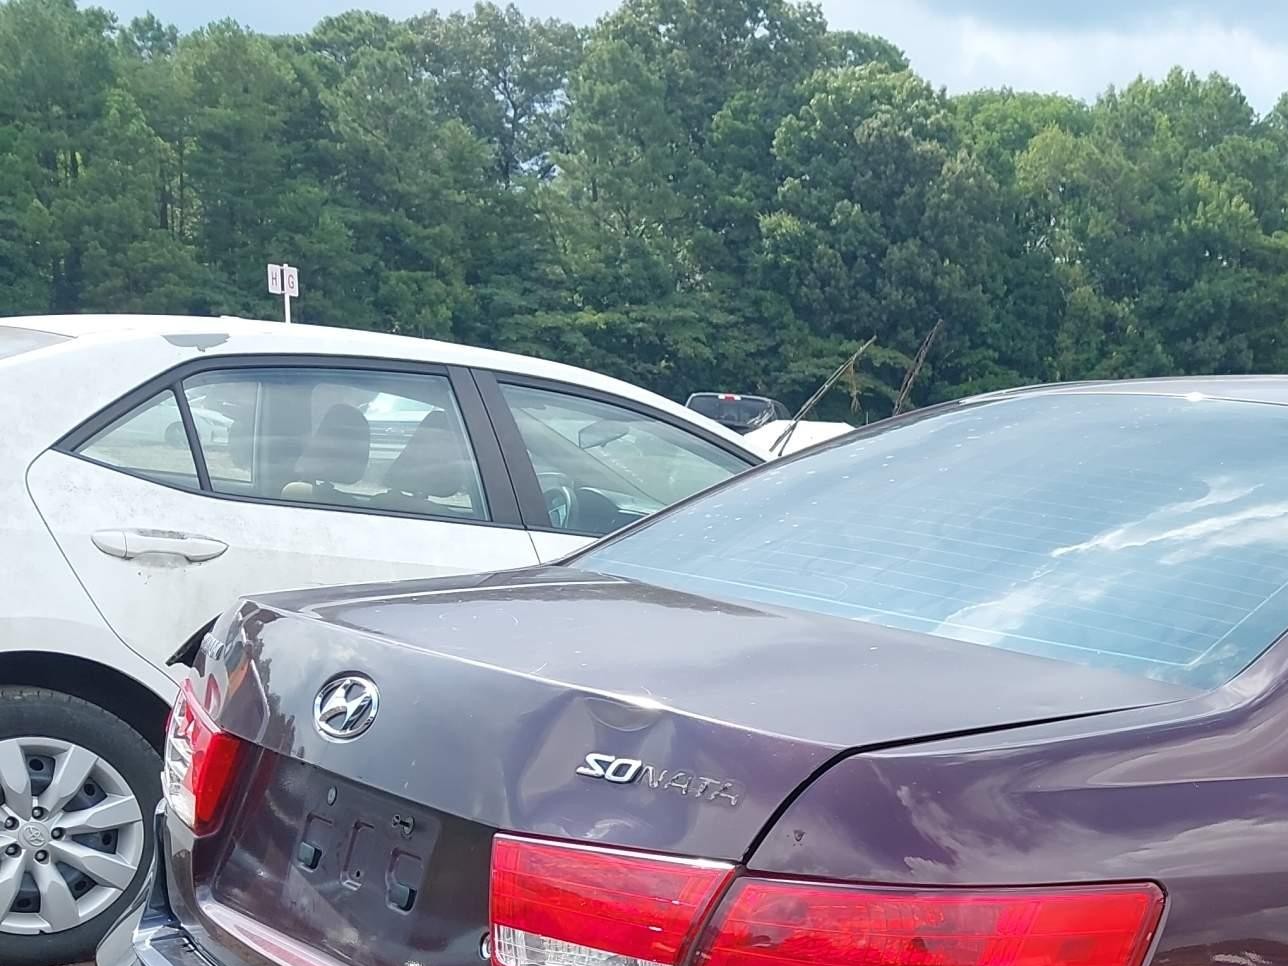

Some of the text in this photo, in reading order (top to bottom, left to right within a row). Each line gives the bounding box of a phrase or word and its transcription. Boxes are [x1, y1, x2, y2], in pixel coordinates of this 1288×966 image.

[271, 271, 278, 287] H
[287, 273, 295, 289] G
[576, 752, 740, 806] SONATA
